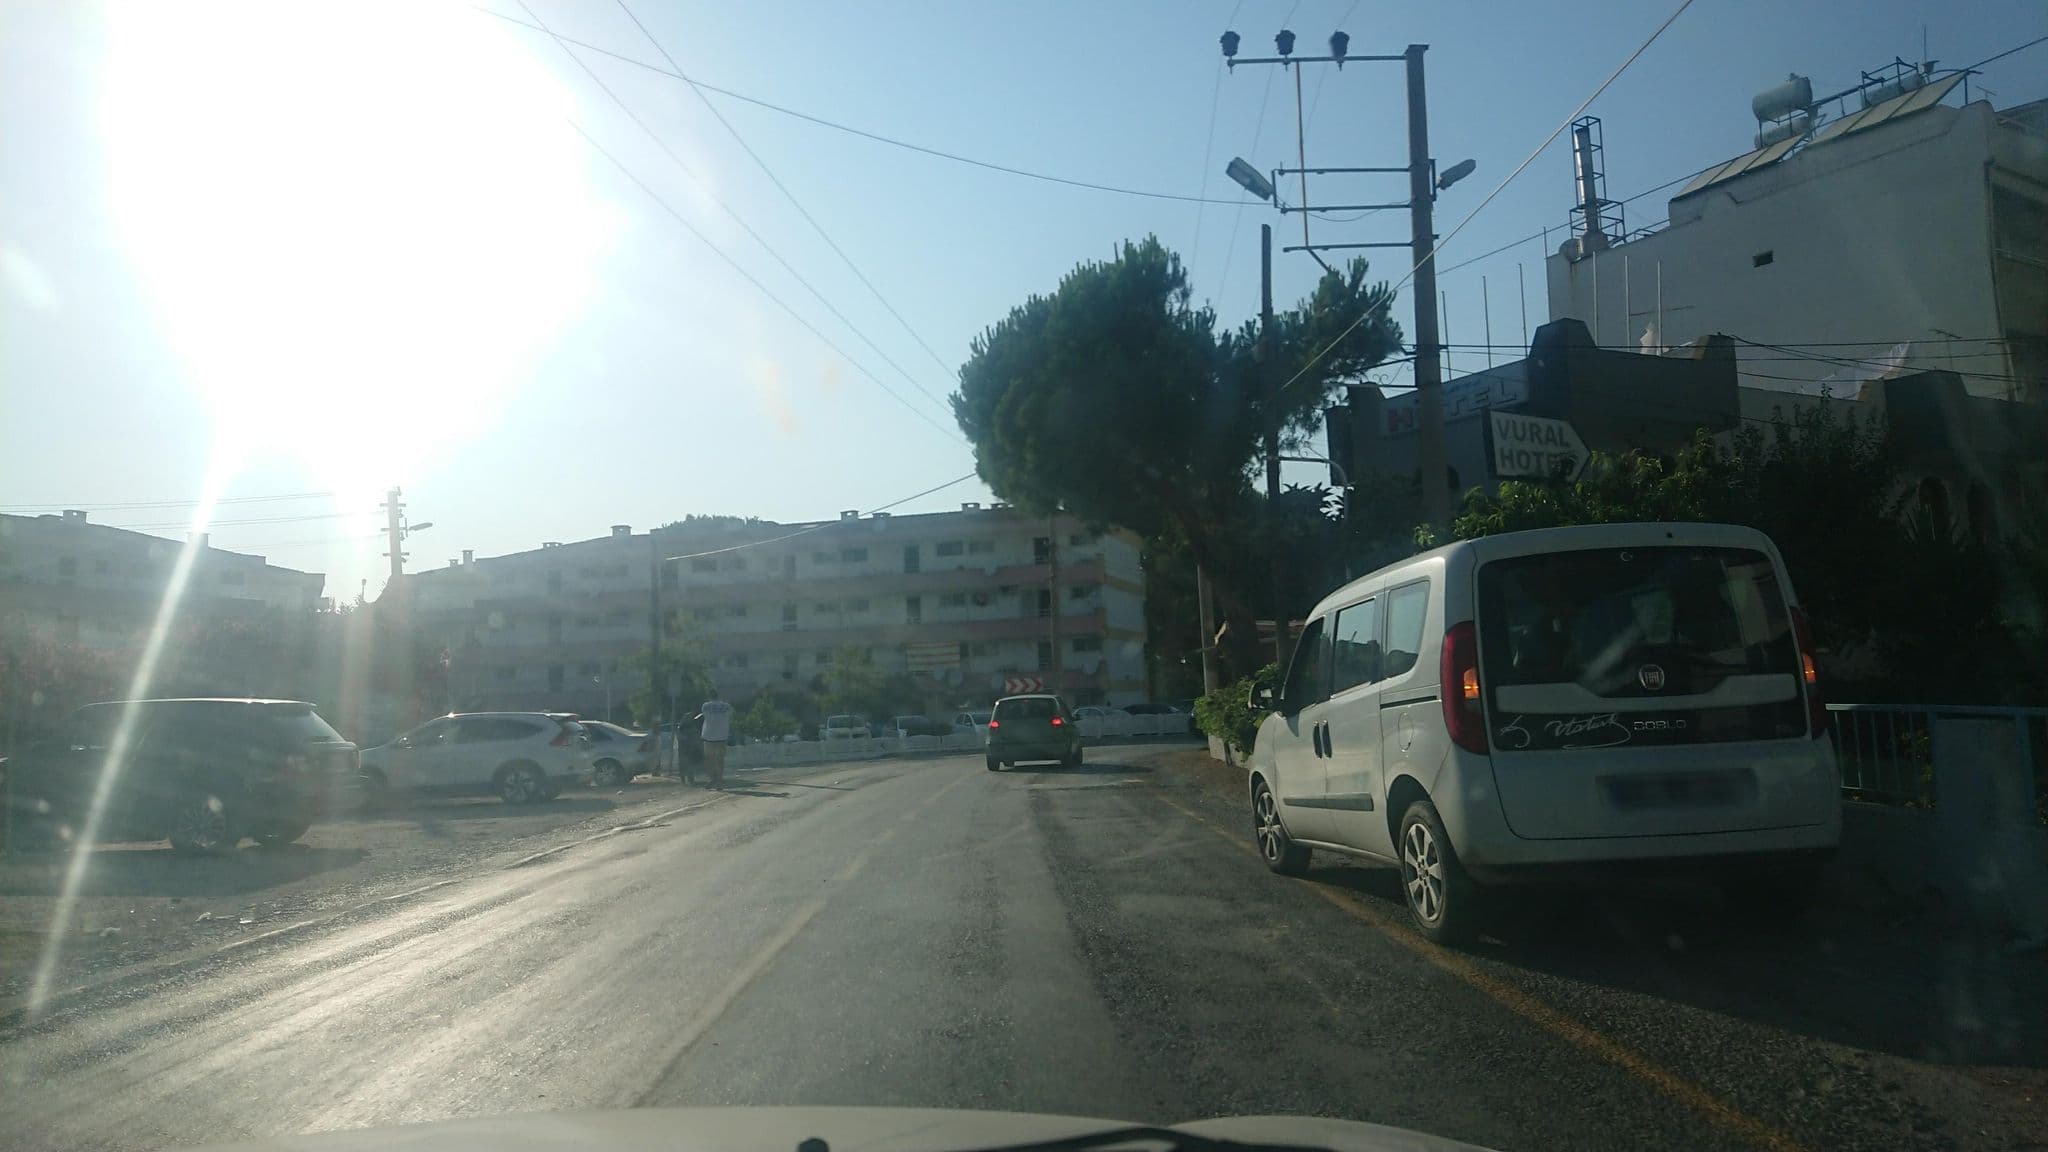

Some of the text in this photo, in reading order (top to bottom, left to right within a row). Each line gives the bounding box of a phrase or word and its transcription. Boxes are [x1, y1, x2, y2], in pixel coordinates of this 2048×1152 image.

[1388, 379, 1518, 432] HTEL
[1496, 416, 1569, 447] VURAL
[1500, 447, 1569, 473] HOTE
